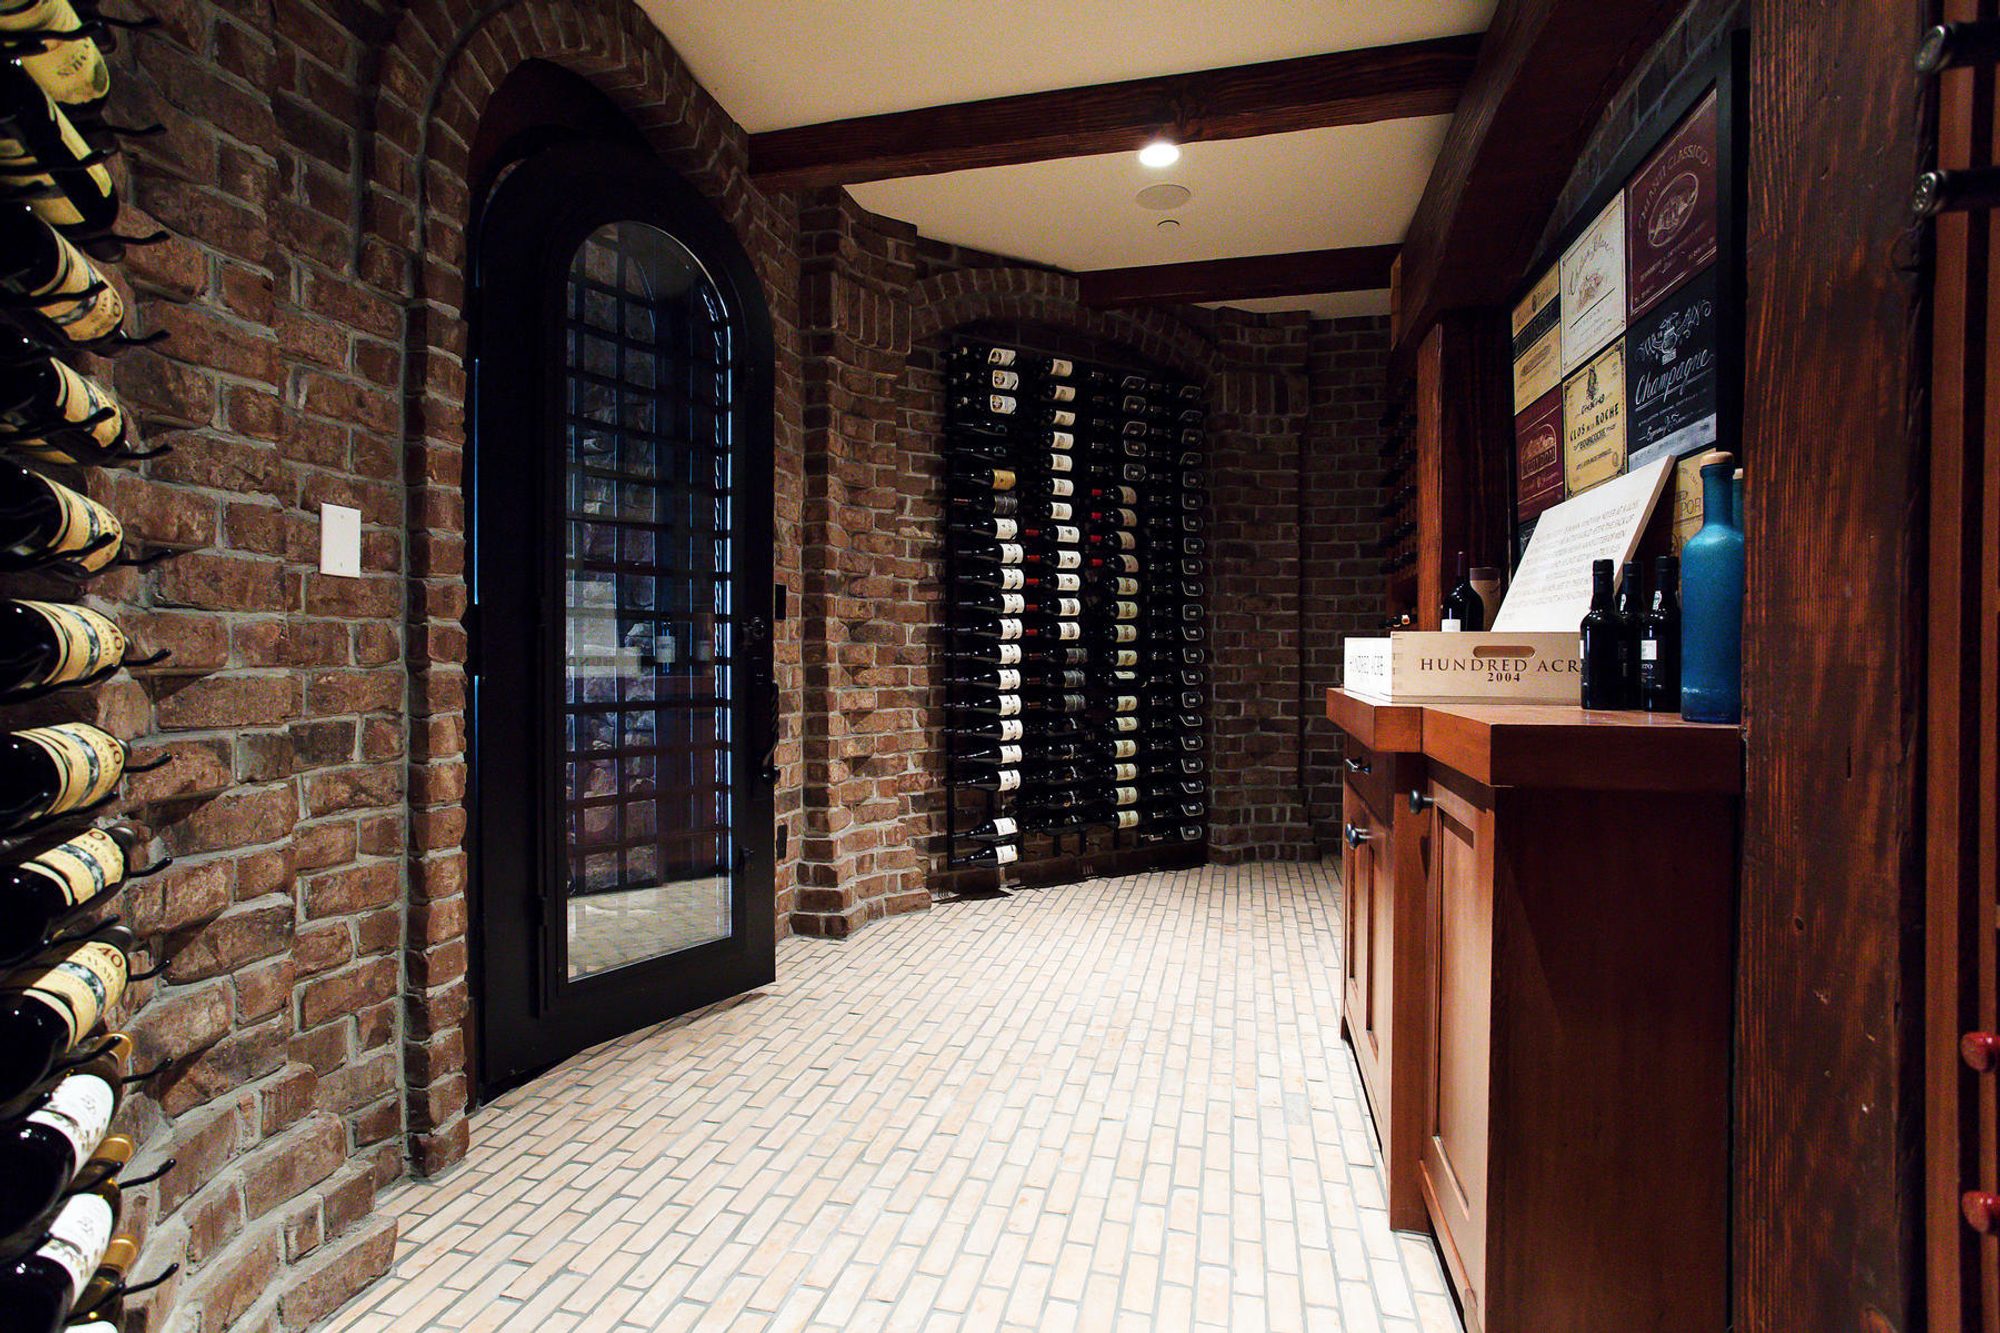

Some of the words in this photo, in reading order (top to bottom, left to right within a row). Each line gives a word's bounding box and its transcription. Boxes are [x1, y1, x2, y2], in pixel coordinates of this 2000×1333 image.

[1635, 348, 1714, 405] Champagne
[1420, 658, 1528, 672] HUNDRED
[1537, 659, 1581, 673] ACR
[1487, 672, 1521, 682] 2004
[97, 947, 123, 968] 40
